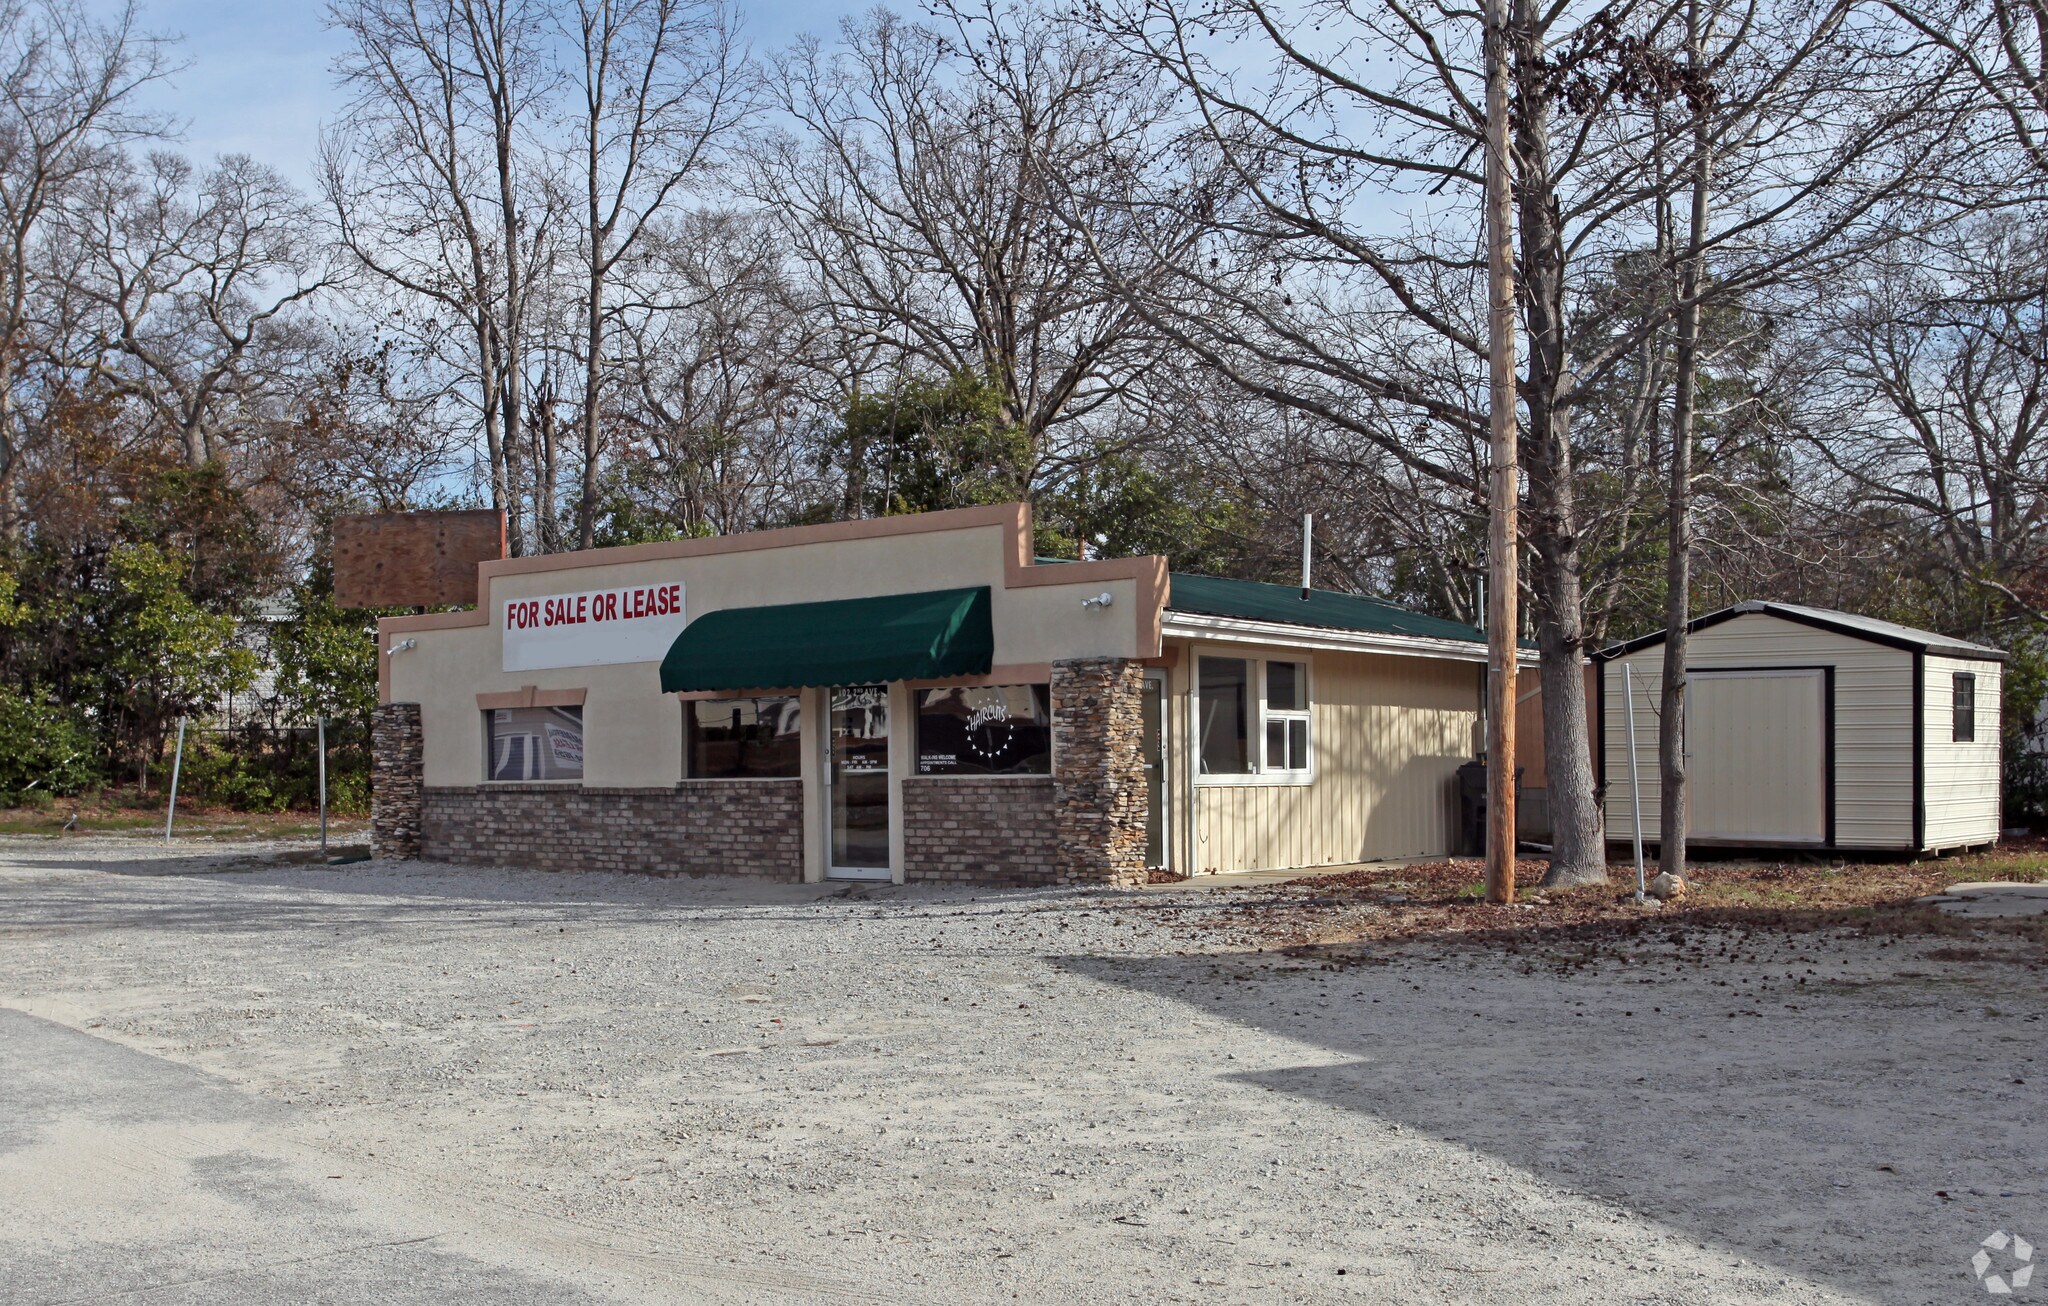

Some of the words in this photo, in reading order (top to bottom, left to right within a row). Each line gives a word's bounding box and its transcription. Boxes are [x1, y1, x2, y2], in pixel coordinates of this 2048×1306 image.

[507, 601, 540, 630] FOR
[544, 596, 588, 627] SALE
[592, 593, 617, 622] OR
[623, 585, 681, 620] LEASE
[838, 688, 851, 698] 102
[970, 705, 1006, 732] HAIRCUTS
